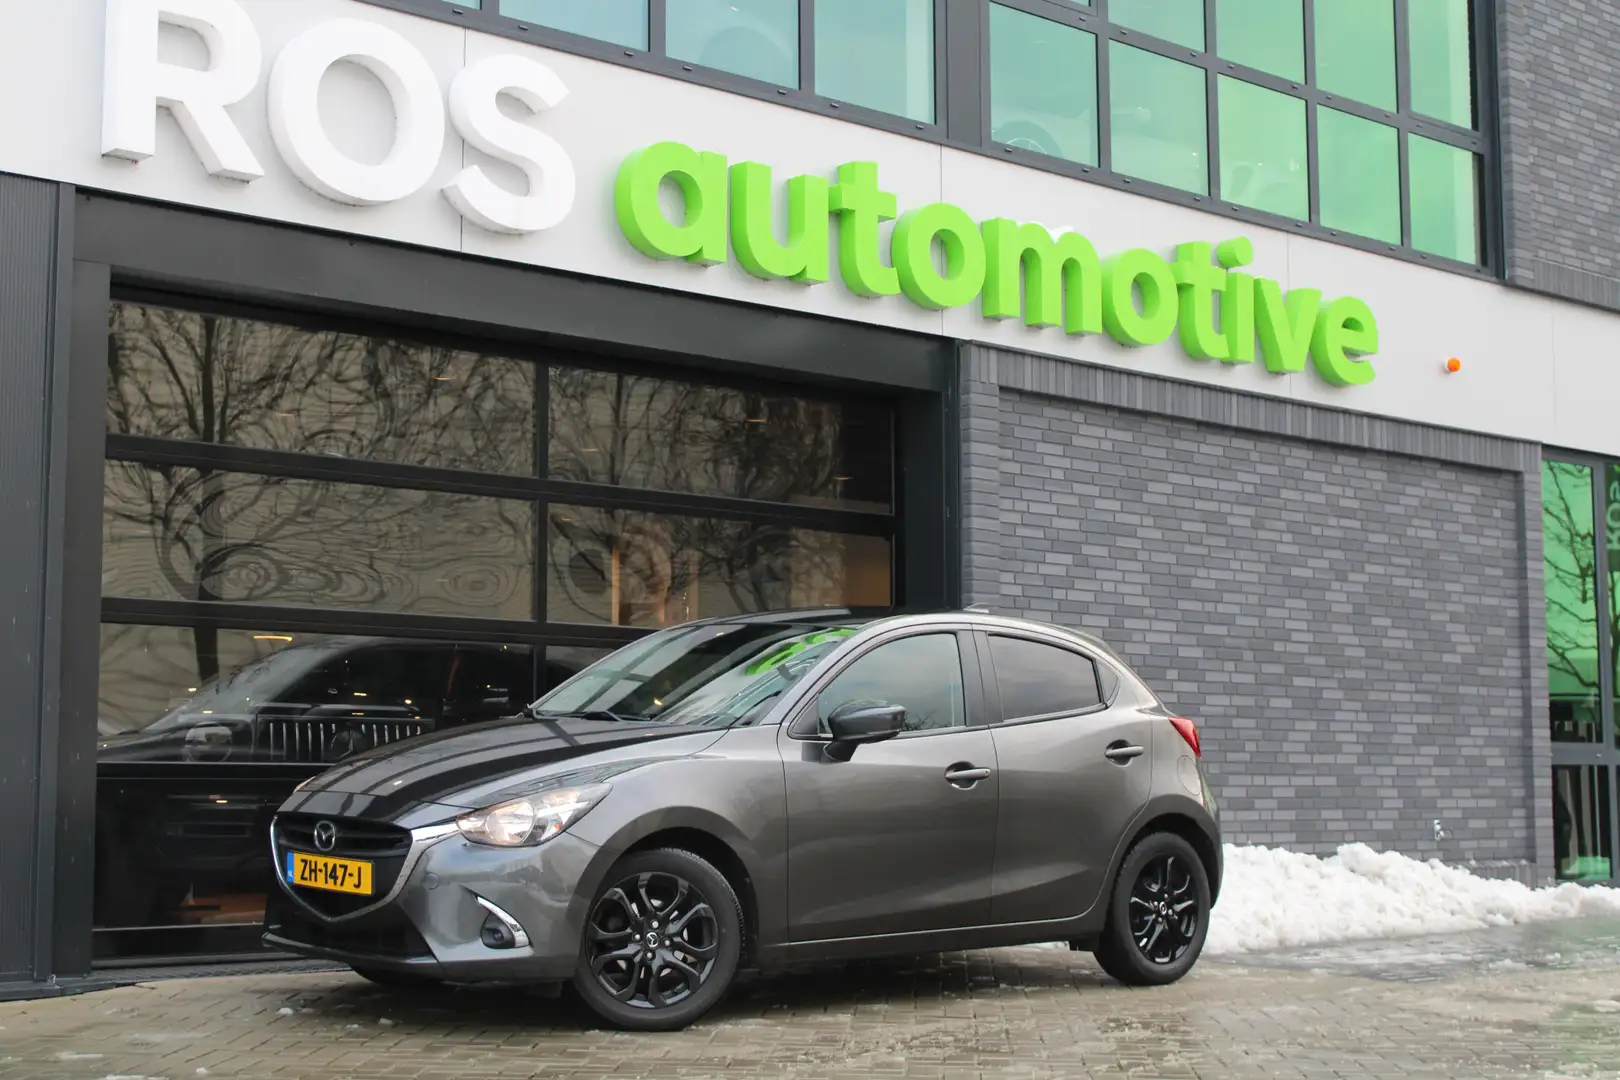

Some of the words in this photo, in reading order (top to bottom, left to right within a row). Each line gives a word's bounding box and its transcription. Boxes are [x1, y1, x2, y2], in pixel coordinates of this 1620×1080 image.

[101, 0, 576, 234] ROS
[615, 141, 1379, 386] automotive
[300, 858, 362, 889] ZH-147-J
